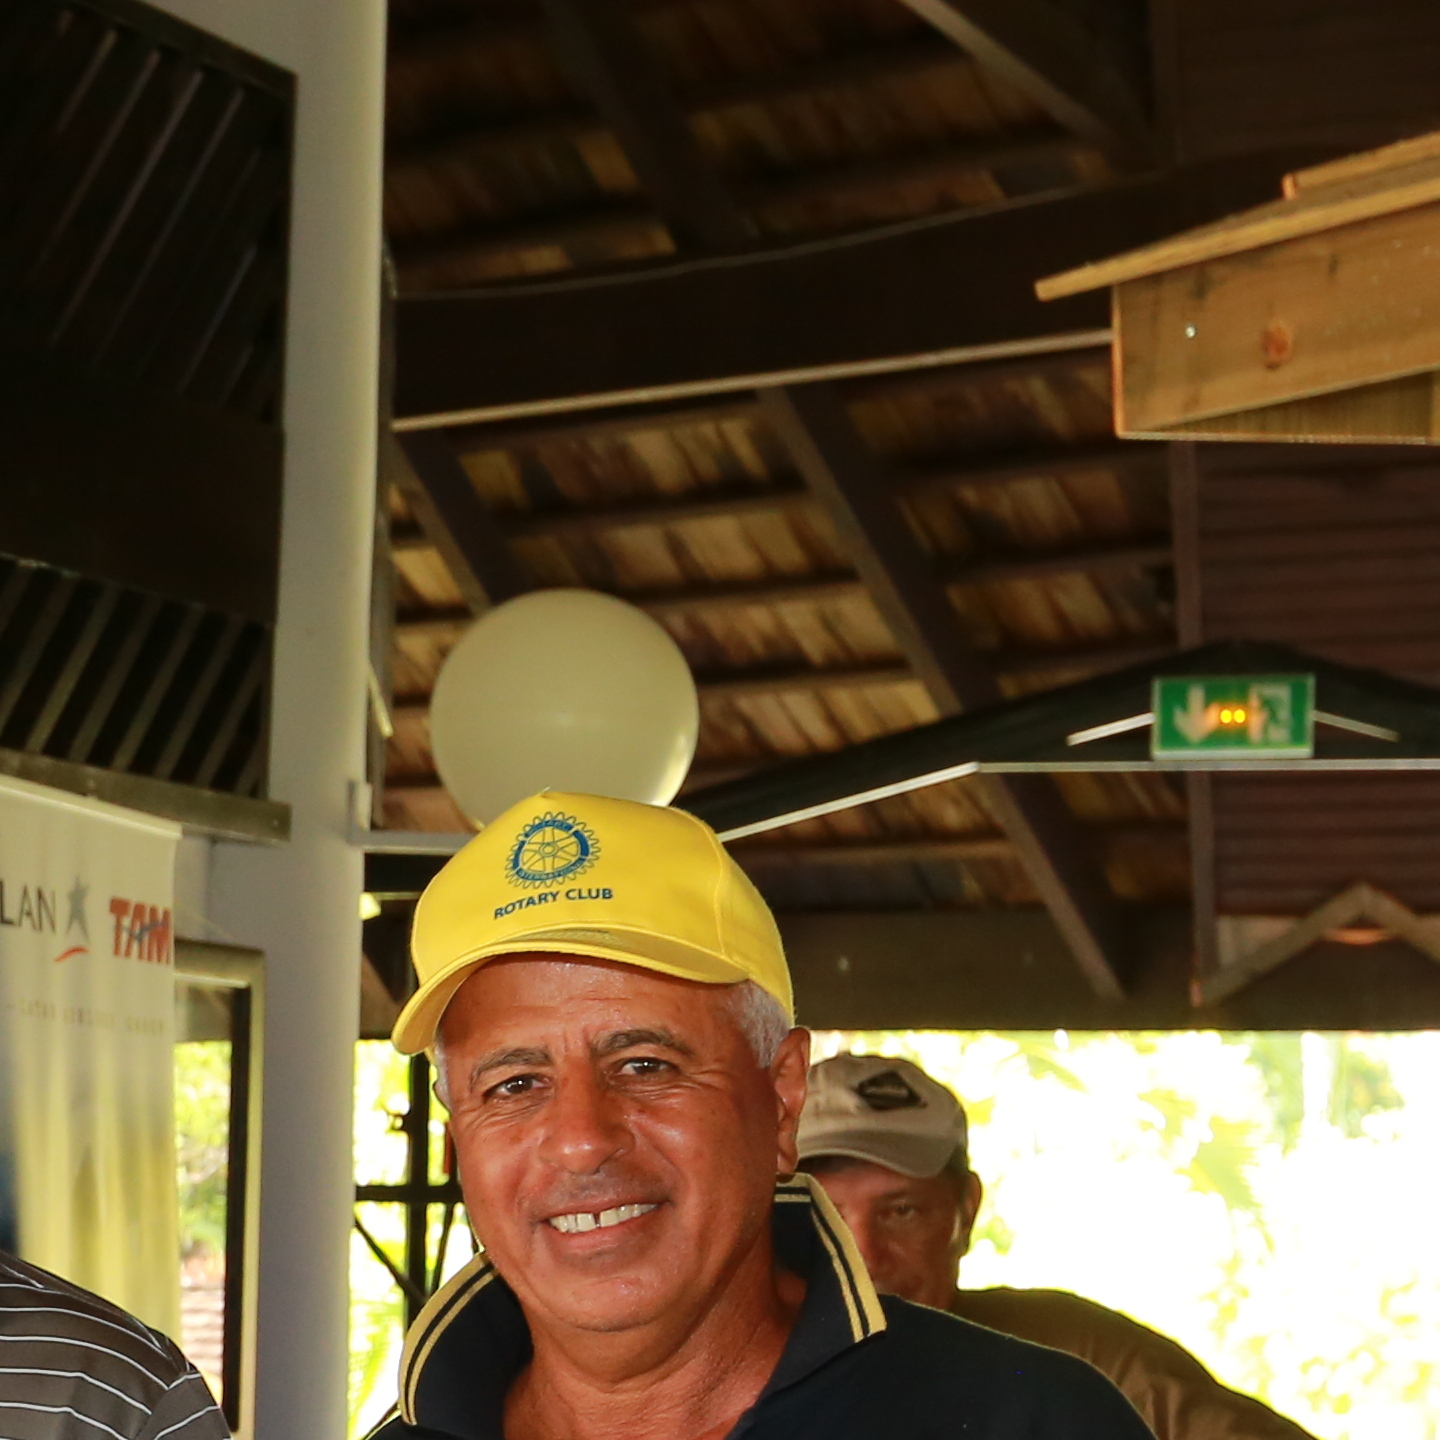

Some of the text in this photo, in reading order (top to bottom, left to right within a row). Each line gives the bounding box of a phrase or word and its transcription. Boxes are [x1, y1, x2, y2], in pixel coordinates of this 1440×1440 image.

[493, 887, 614, 920] ROTARY CLUB
[109, 895, 171, 965] TAM
